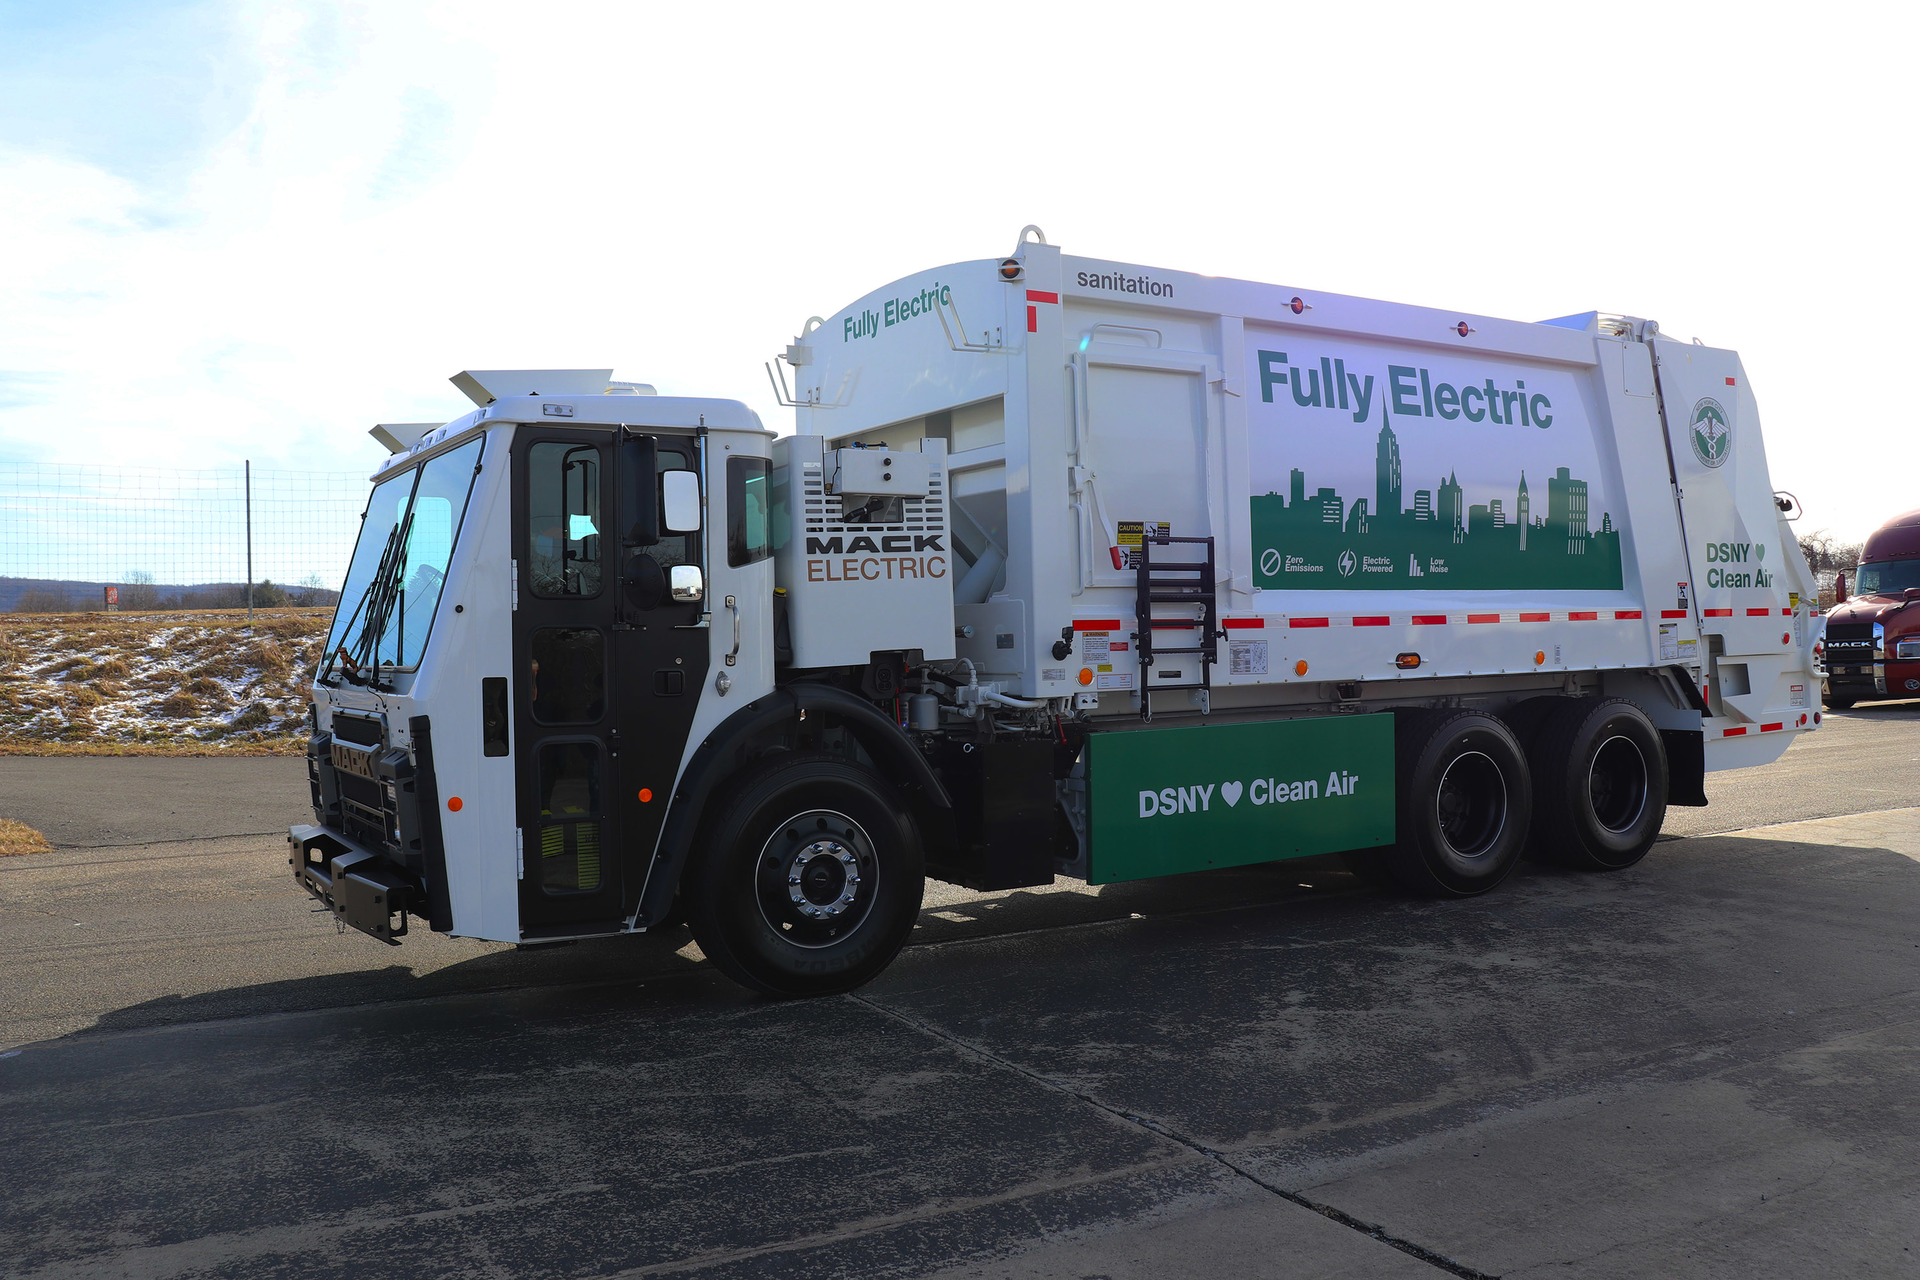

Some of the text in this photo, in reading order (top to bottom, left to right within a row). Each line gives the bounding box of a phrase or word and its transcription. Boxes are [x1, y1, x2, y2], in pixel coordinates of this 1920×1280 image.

[1077, 269, 1174, 298] sanitation
[843, 282, 951, 343] Fully Electric
[1257, 349, 1553, 430] Fully Electric
[1119, 524, 1144, 532] CAUTION
[806, 535, 944, 555] MACK
[1706, 542, 1750, 564] DSNY
[807, 557, 946, 582] ELECTRIC
[1285, 554, 1304, 565] Zero
[1285, 563, 1324, 573] Emissions
[1362, 564, 1394, 574] Powered
[1363, 555, 1391, 566] Electric
[1429, 564, 1449, 574] Noise
[1430, 556, 1445, 566] Low
[1706, 567, 1774, 589] Clean Air
[330, 744, 374, 778] MACK
[1138, 770, 1359, 819] DSNY Clean Air
